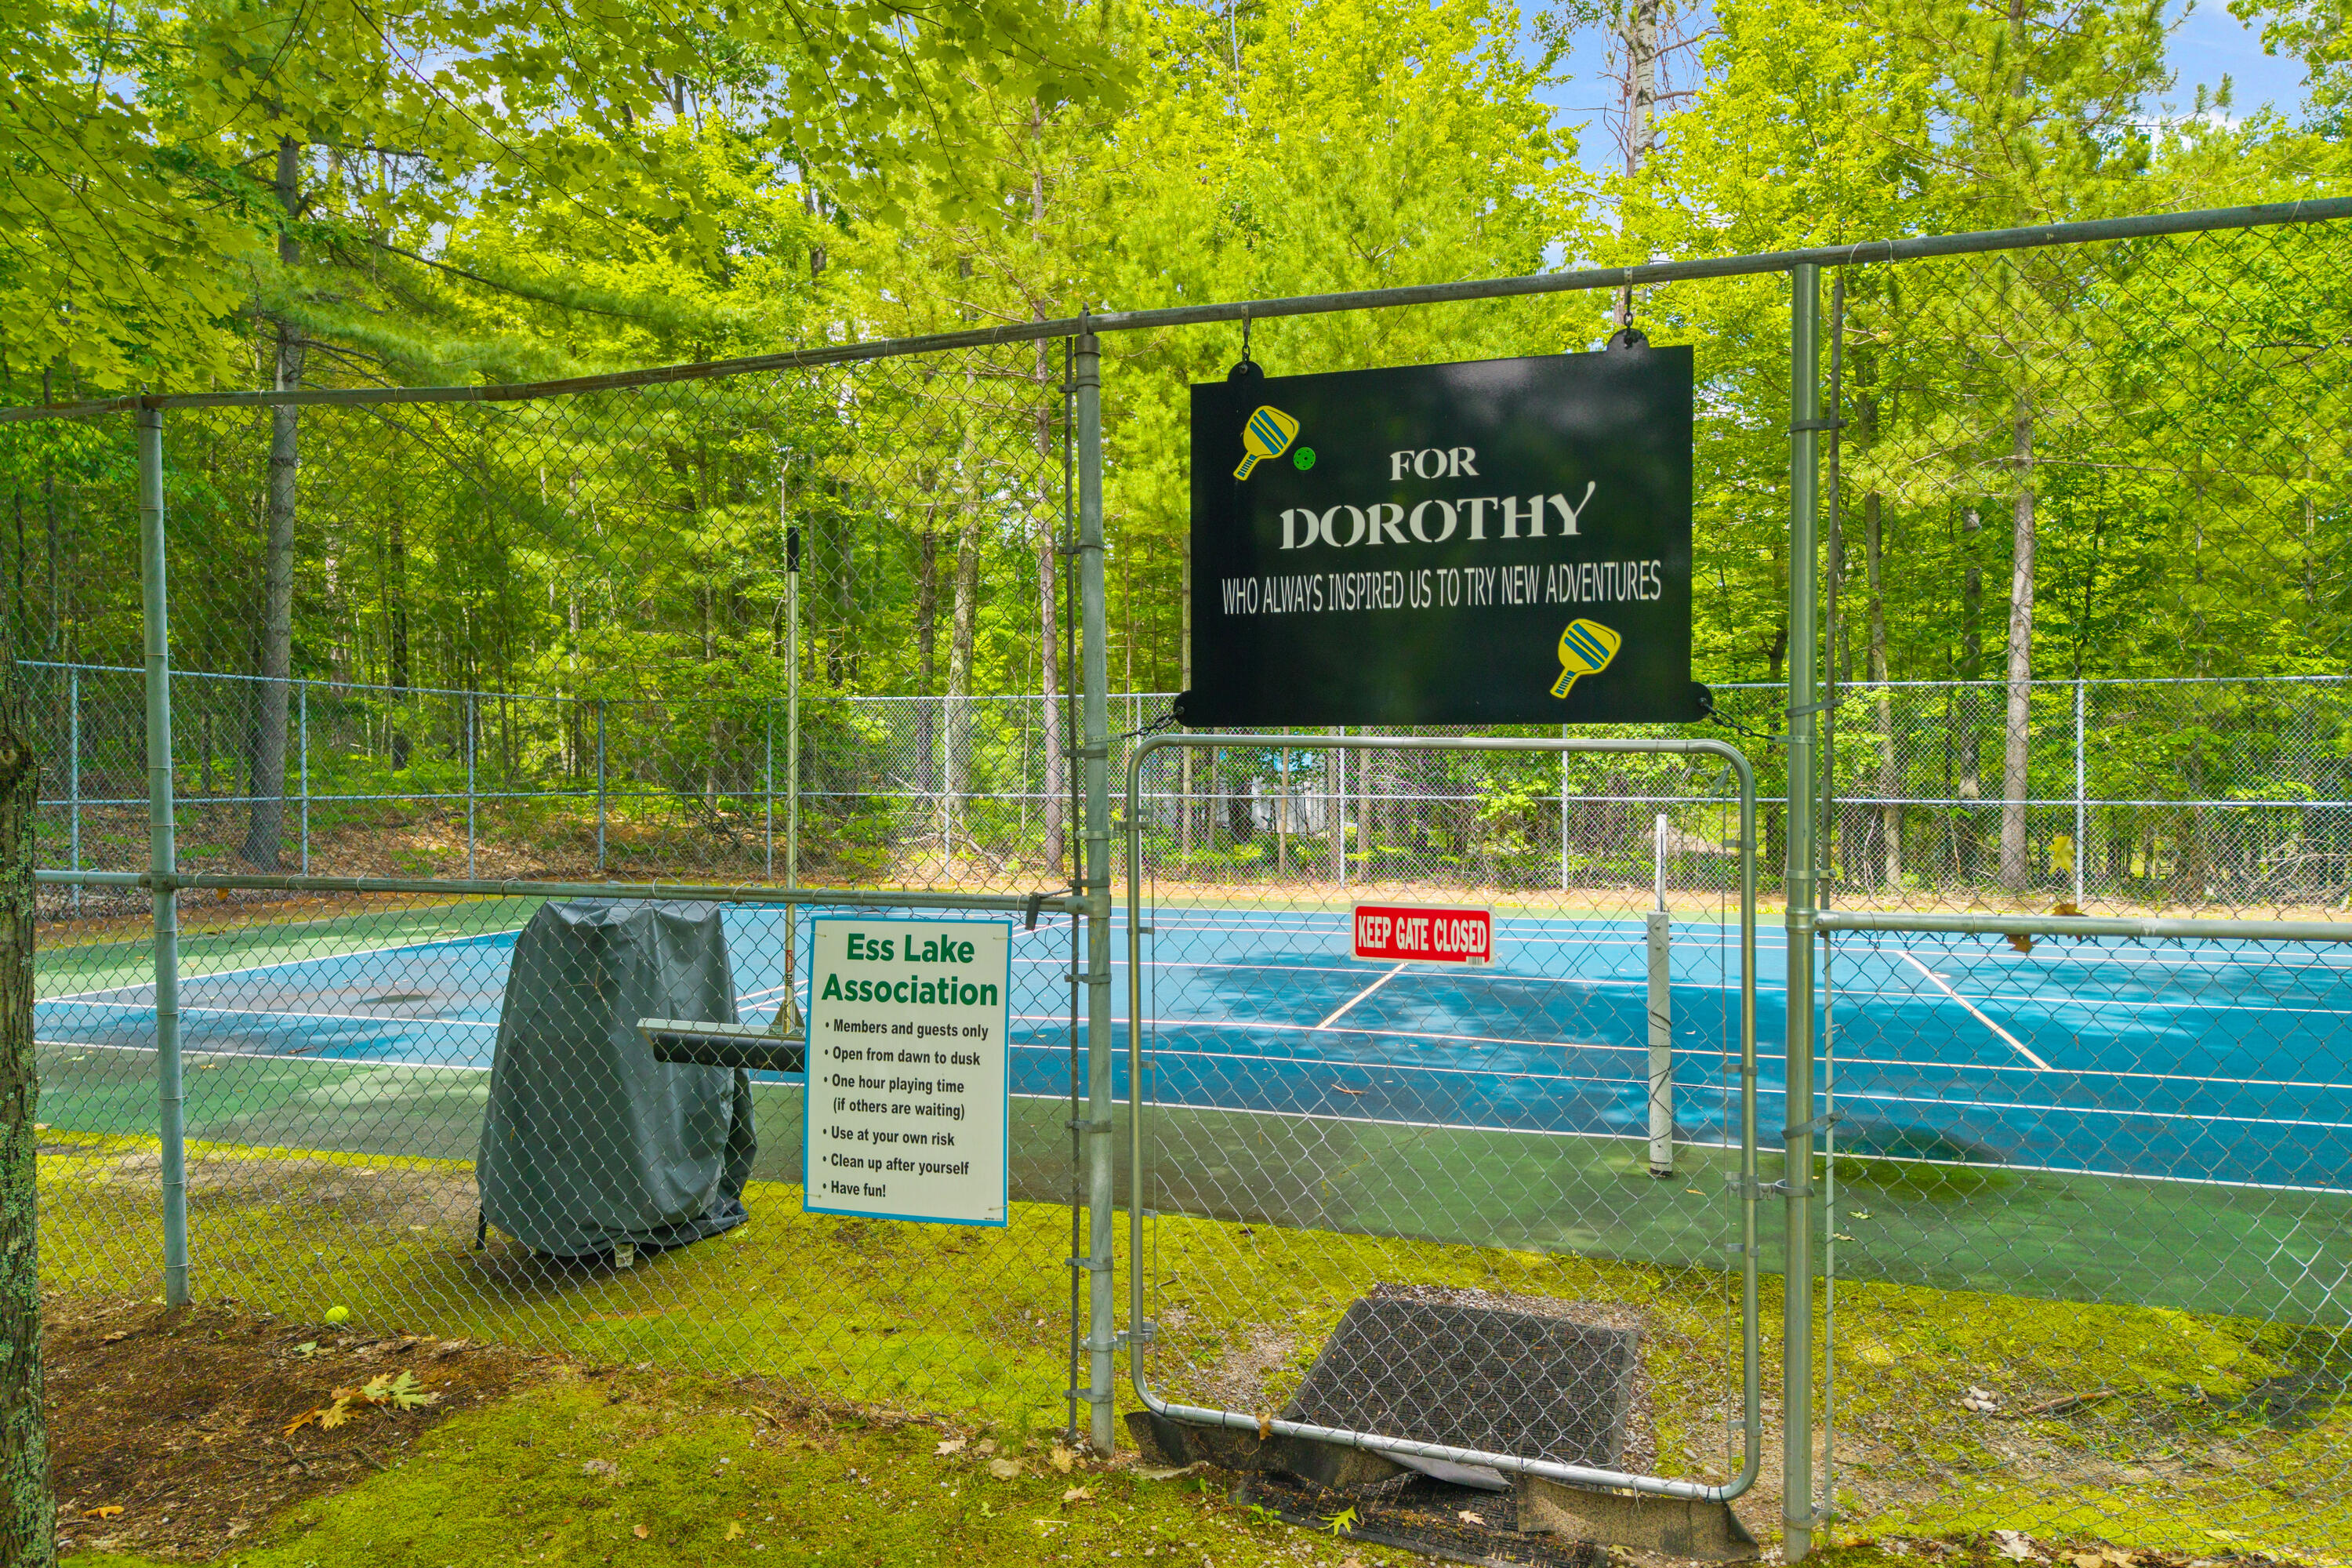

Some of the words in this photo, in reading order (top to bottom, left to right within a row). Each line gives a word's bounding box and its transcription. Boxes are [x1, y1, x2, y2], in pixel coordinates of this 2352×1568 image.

[1389, 446, 1479, 481] FOR
[1279, 481, 1596, 550] DOROTHY
[1221, 576, 1258, 615] WHO
[1262, 574, 1323, 613] ALWAYS
[1328, 570, 1404, 611] INSPIRED
[1410, 569, 1432, 608] US
[1436, 568, 1460, 607] TO
[1464, 567, 1496, 606] TRY
[1501, 565, 1540, 605] NEW
[1545, 559, 1661, 604] ADVENTURES
[1358, 915, 1392, 949] KEEP
[1396, 916, 1429, 951] GATE
[1433, 918, 1487, 953] CLOSED
[847, 933, 895, 962] Ess
[904, 934, 975, 964] Lake
[821, 973, 998, 1006] Association
[833, 1018, 887, 1034] Members
[891, 1022, 913, 1035] and
[916, 1023, 958, 1039] guests
[962, 1024, 989, 1041] only
[833, 1046, 863, 1063] Open
[866, 1047, 894, 1062] from
[898, 1049, 931, 1064] dawn
[934, 1051, 947, 1065] to
[950, 1051, 981, 1065] dusk
[832, 1073, 855, 1087] One
[858, 1074, 886, 1089] hour
[889, 1076, 933, 1095] playing
[936, 1078, 964, 1093] time
[833, 1097, 846, 1114] (if
[849, 1098, 887, 1113] others
[891, 1103, 911, 1115] are
[914, 1102, 965, 1121] waiting)
[831, 1125, 854, 1140] Use
[857, 1128, 869, 1142] at
[872, 1131, 899, 1145] your
[902, 1133, 927, 1145] own
[931, 1132, 955, 1146] risk
[830, 1152, 864, 1168] Clean
[868, 1159, 883, 1173] up
[886, 1157, 916, 1172] after
[918, 1161, 970, 1176] yourself
[831, 1180, 860, 1196] Have
[863, 1182, 886, 1198] fun!
